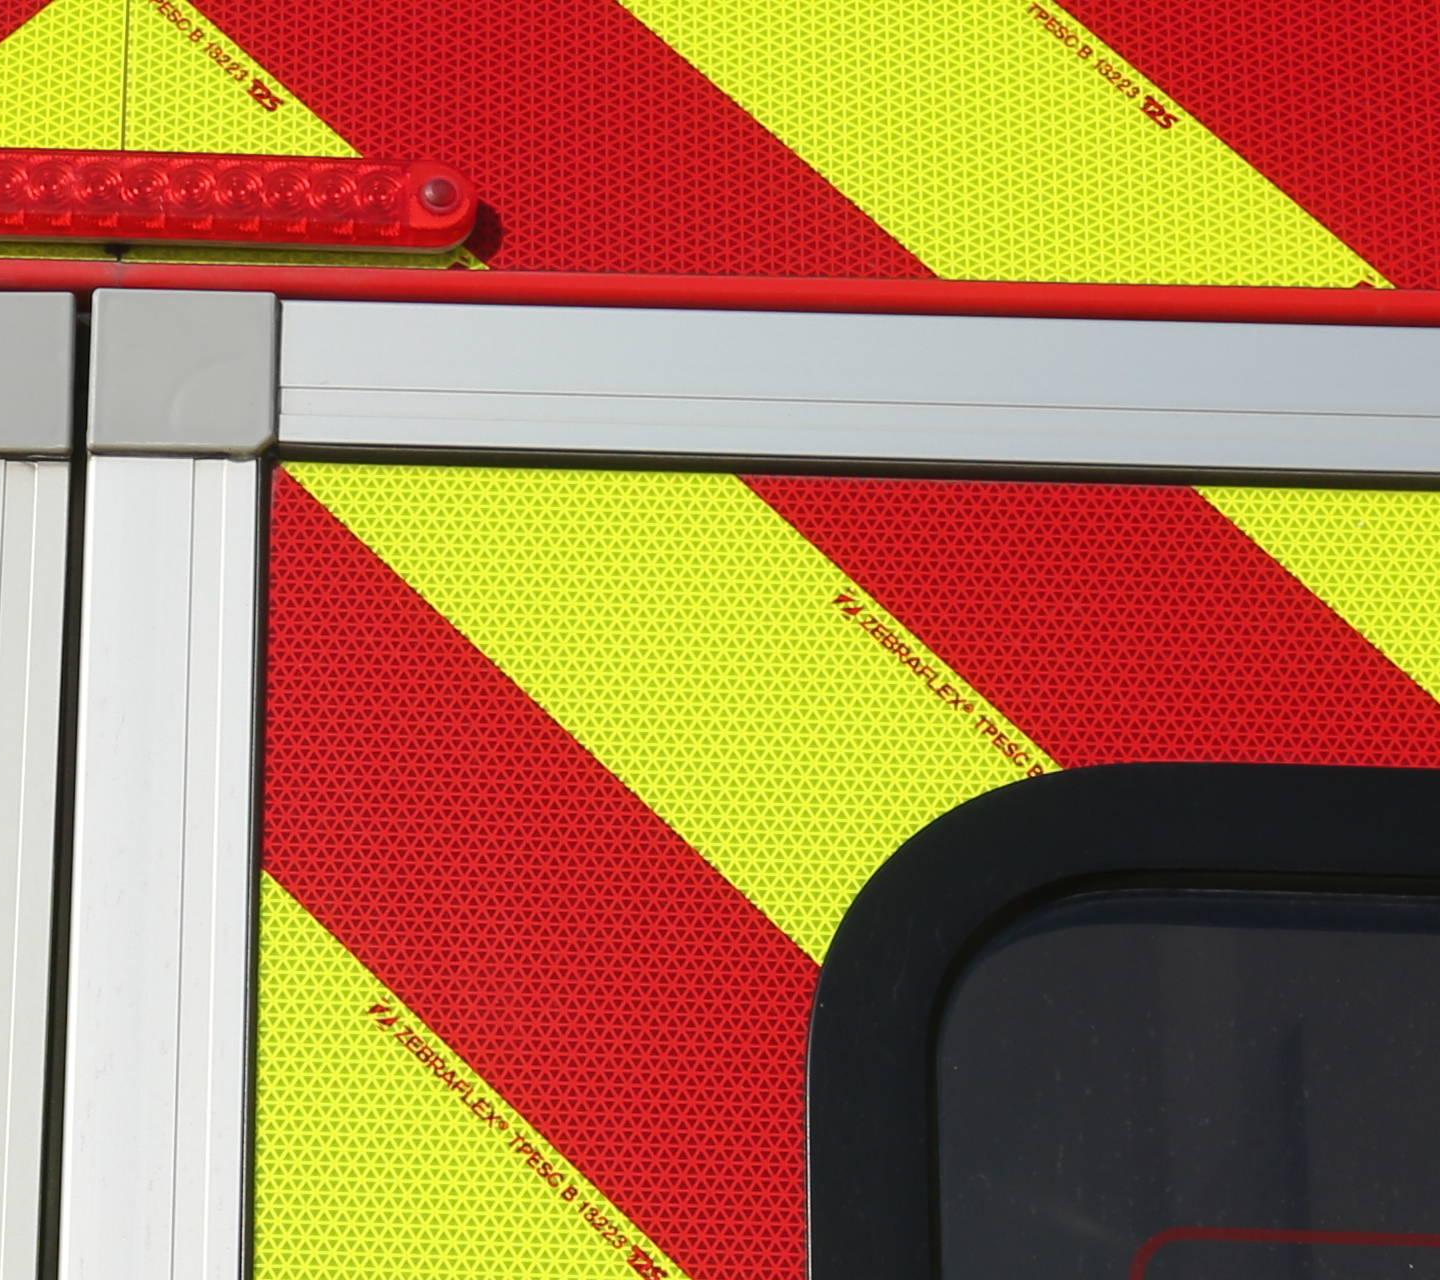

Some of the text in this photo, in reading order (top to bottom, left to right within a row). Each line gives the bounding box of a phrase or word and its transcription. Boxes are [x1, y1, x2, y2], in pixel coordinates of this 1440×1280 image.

[187, 26, 204, 43] B
[203, 40, 250, 83] 13223
[1027, 1, 1080, 46] TPESC
[1075, 42, 1095, 60] B
[1092, 56, 1142, 100] 13223
[974, 716, 1029, 766] TPESC
[1025, 762, 1046, 780] B
[509, 1134, 564, 1189] TPESC
[561, 1184, 580, 1203] B
[577, 1199, 630, 1251] 13223
